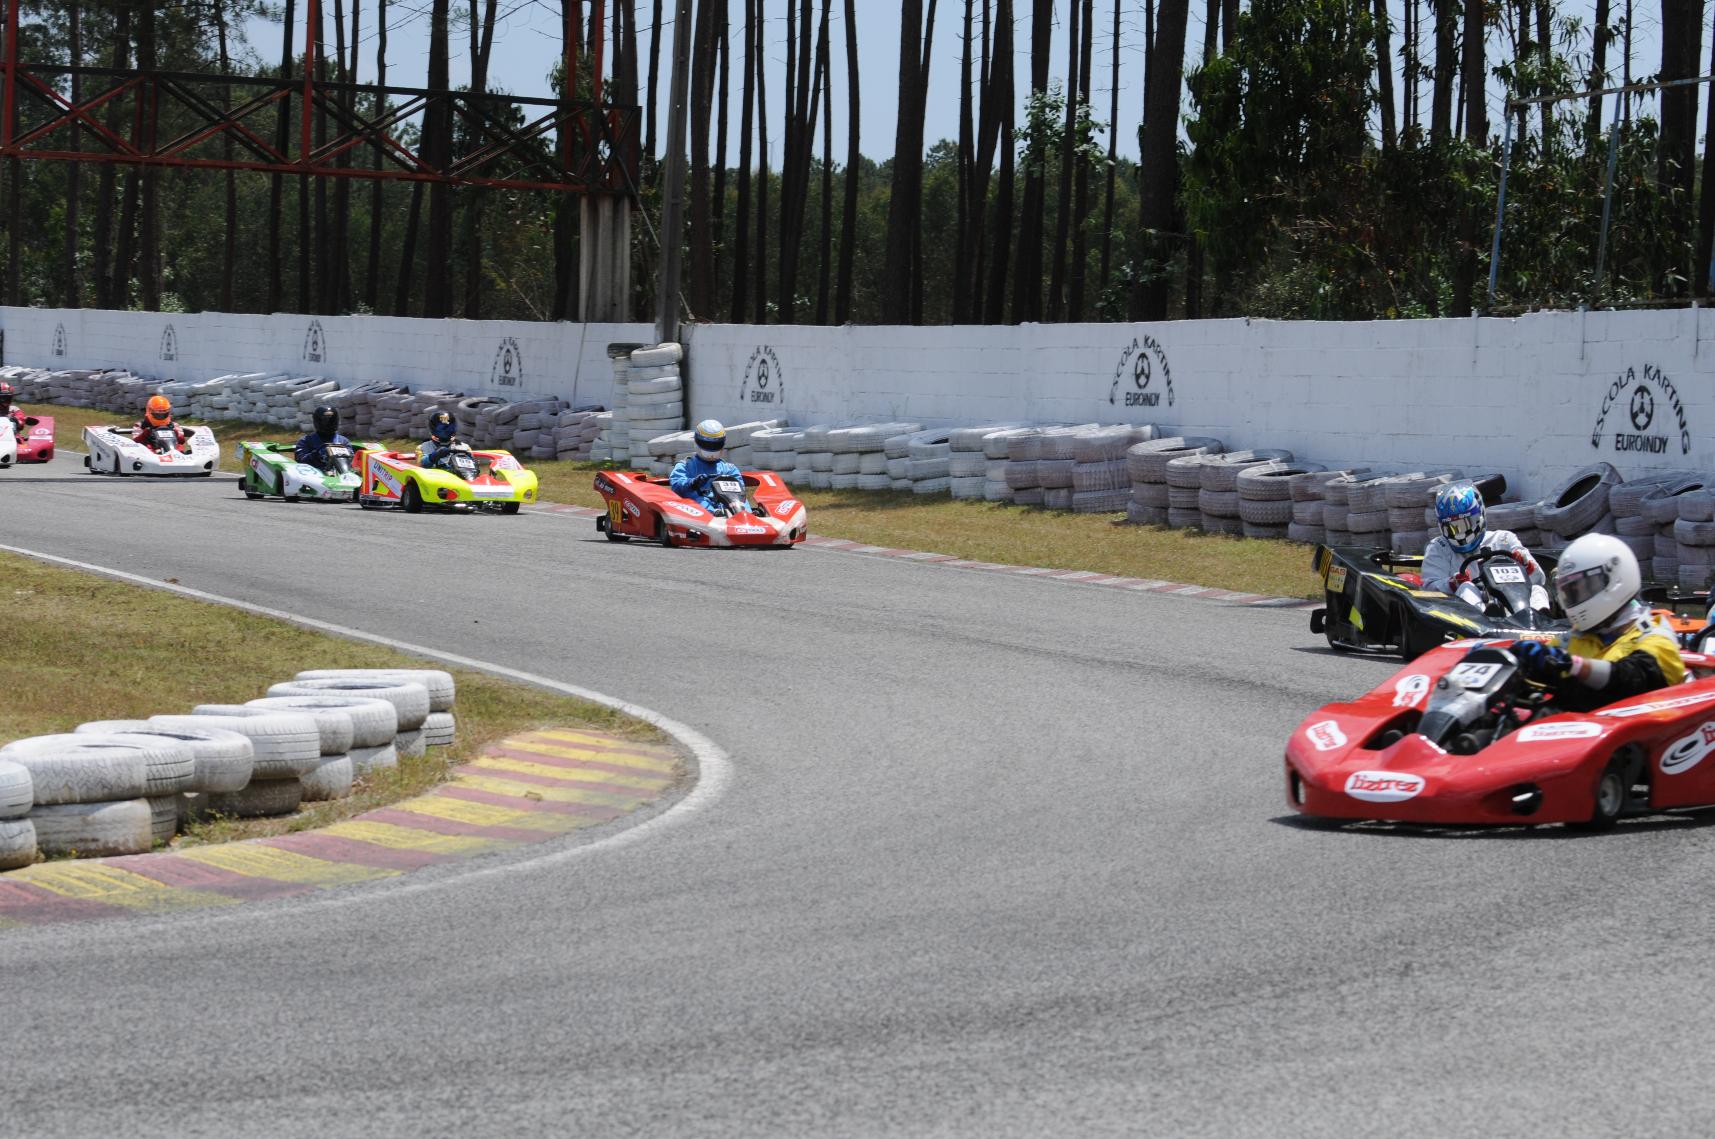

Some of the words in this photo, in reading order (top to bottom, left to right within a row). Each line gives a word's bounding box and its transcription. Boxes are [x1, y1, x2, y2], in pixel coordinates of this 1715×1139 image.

[1144, 334, 1176, 407] KARTING
[1125, 391, 1161, 407] EUROINDY
[1591, 366, 1635, 449] ESCOLA
[1643, 363, 1692, 455] KARTING
[1615, 433, 1669, 454] EUROINDY
[373, 461, 393, 481] UNITRIP
[610, 500, 619, 521] 39
[1458, 665, 1493, 676] 74
[1350, 774, 1421, 792] liztrez
